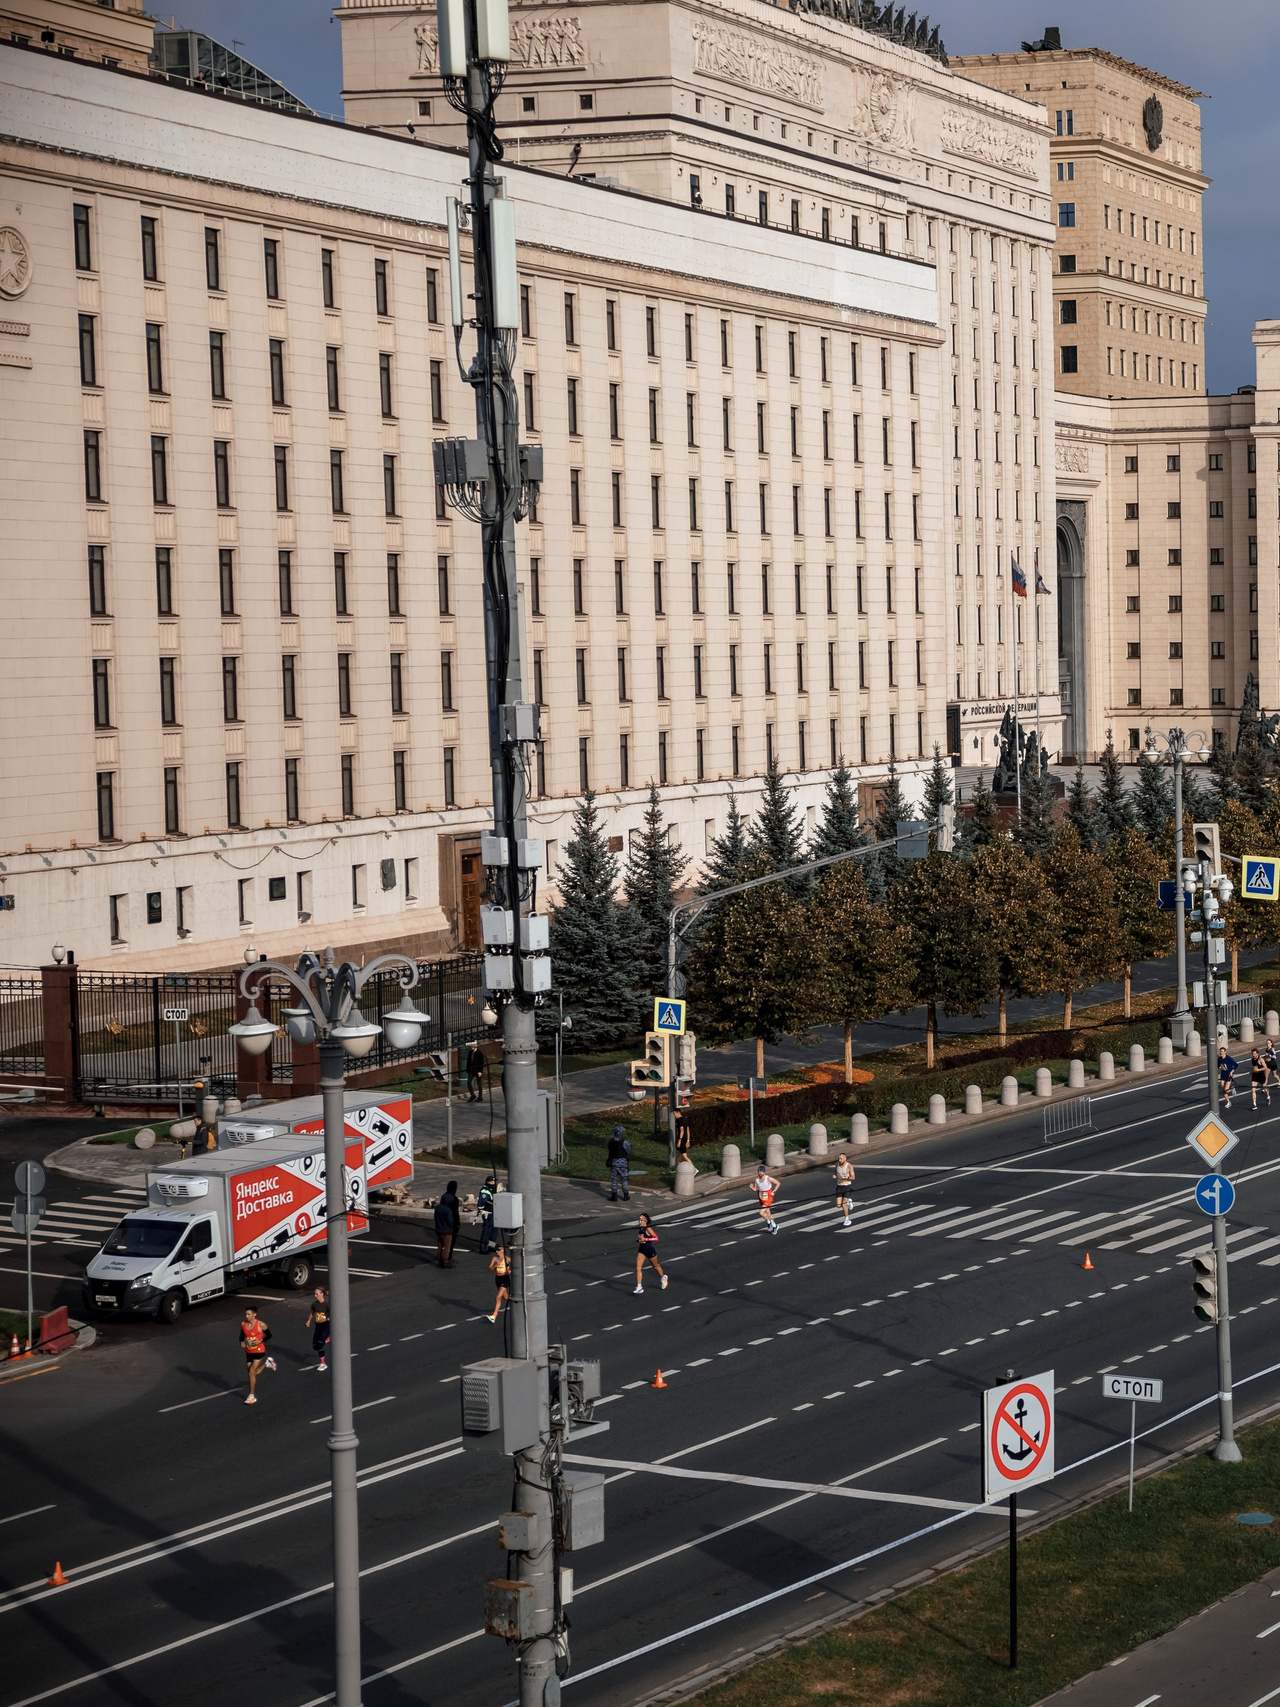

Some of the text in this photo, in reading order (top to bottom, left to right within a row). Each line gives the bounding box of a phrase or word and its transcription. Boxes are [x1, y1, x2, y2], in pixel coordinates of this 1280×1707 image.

[971, 702, 1037, 715] РОССИЙСКОЙ ЕЕРАЦИИ
[166, 1010, 186, 1019] СТОП
[236, 1176, 279, 1200] Яндекс
[236, 1190, 294, 1221] Доставка
[298, 1215, 308, 1234] Я
[198, 1291, 211, 1299] NEXT
[1111, 1379, 1153, 1397] СТОП
